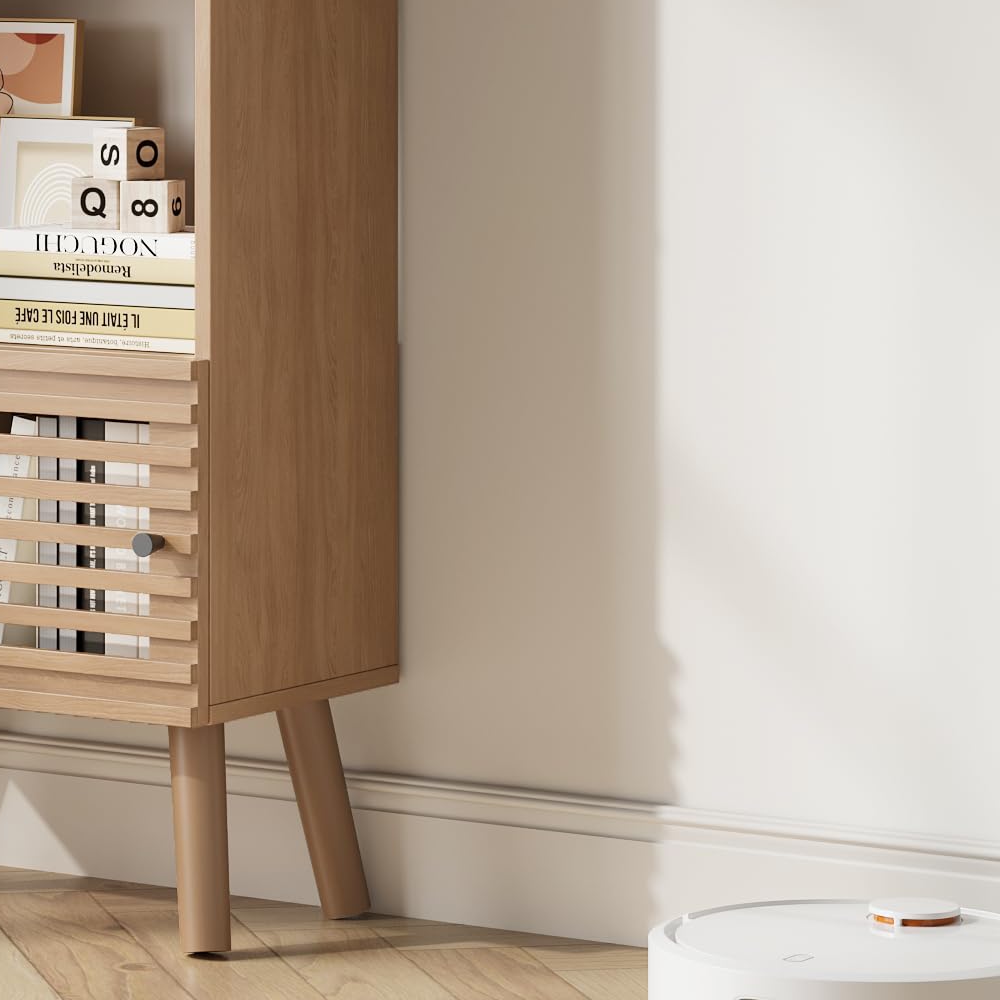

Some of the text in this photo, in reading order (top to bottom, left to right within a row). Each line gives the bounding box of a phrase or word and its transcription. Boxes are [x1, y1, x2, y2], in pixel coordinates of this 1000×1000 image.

[100, 143, 120, 166] S
[135, 139, 158, 168] O
[80, 187, 107, 219] Q
[131, 198, 159, 218] 8
[35, 233, 158, 257] NOGUCHI
[53, 261, 131, 278] Remodelista
[15, 307, 140, 331] IL ÉTAIT UNE FOIS LE CAFÉ
[57, 335, 65, 343] et
